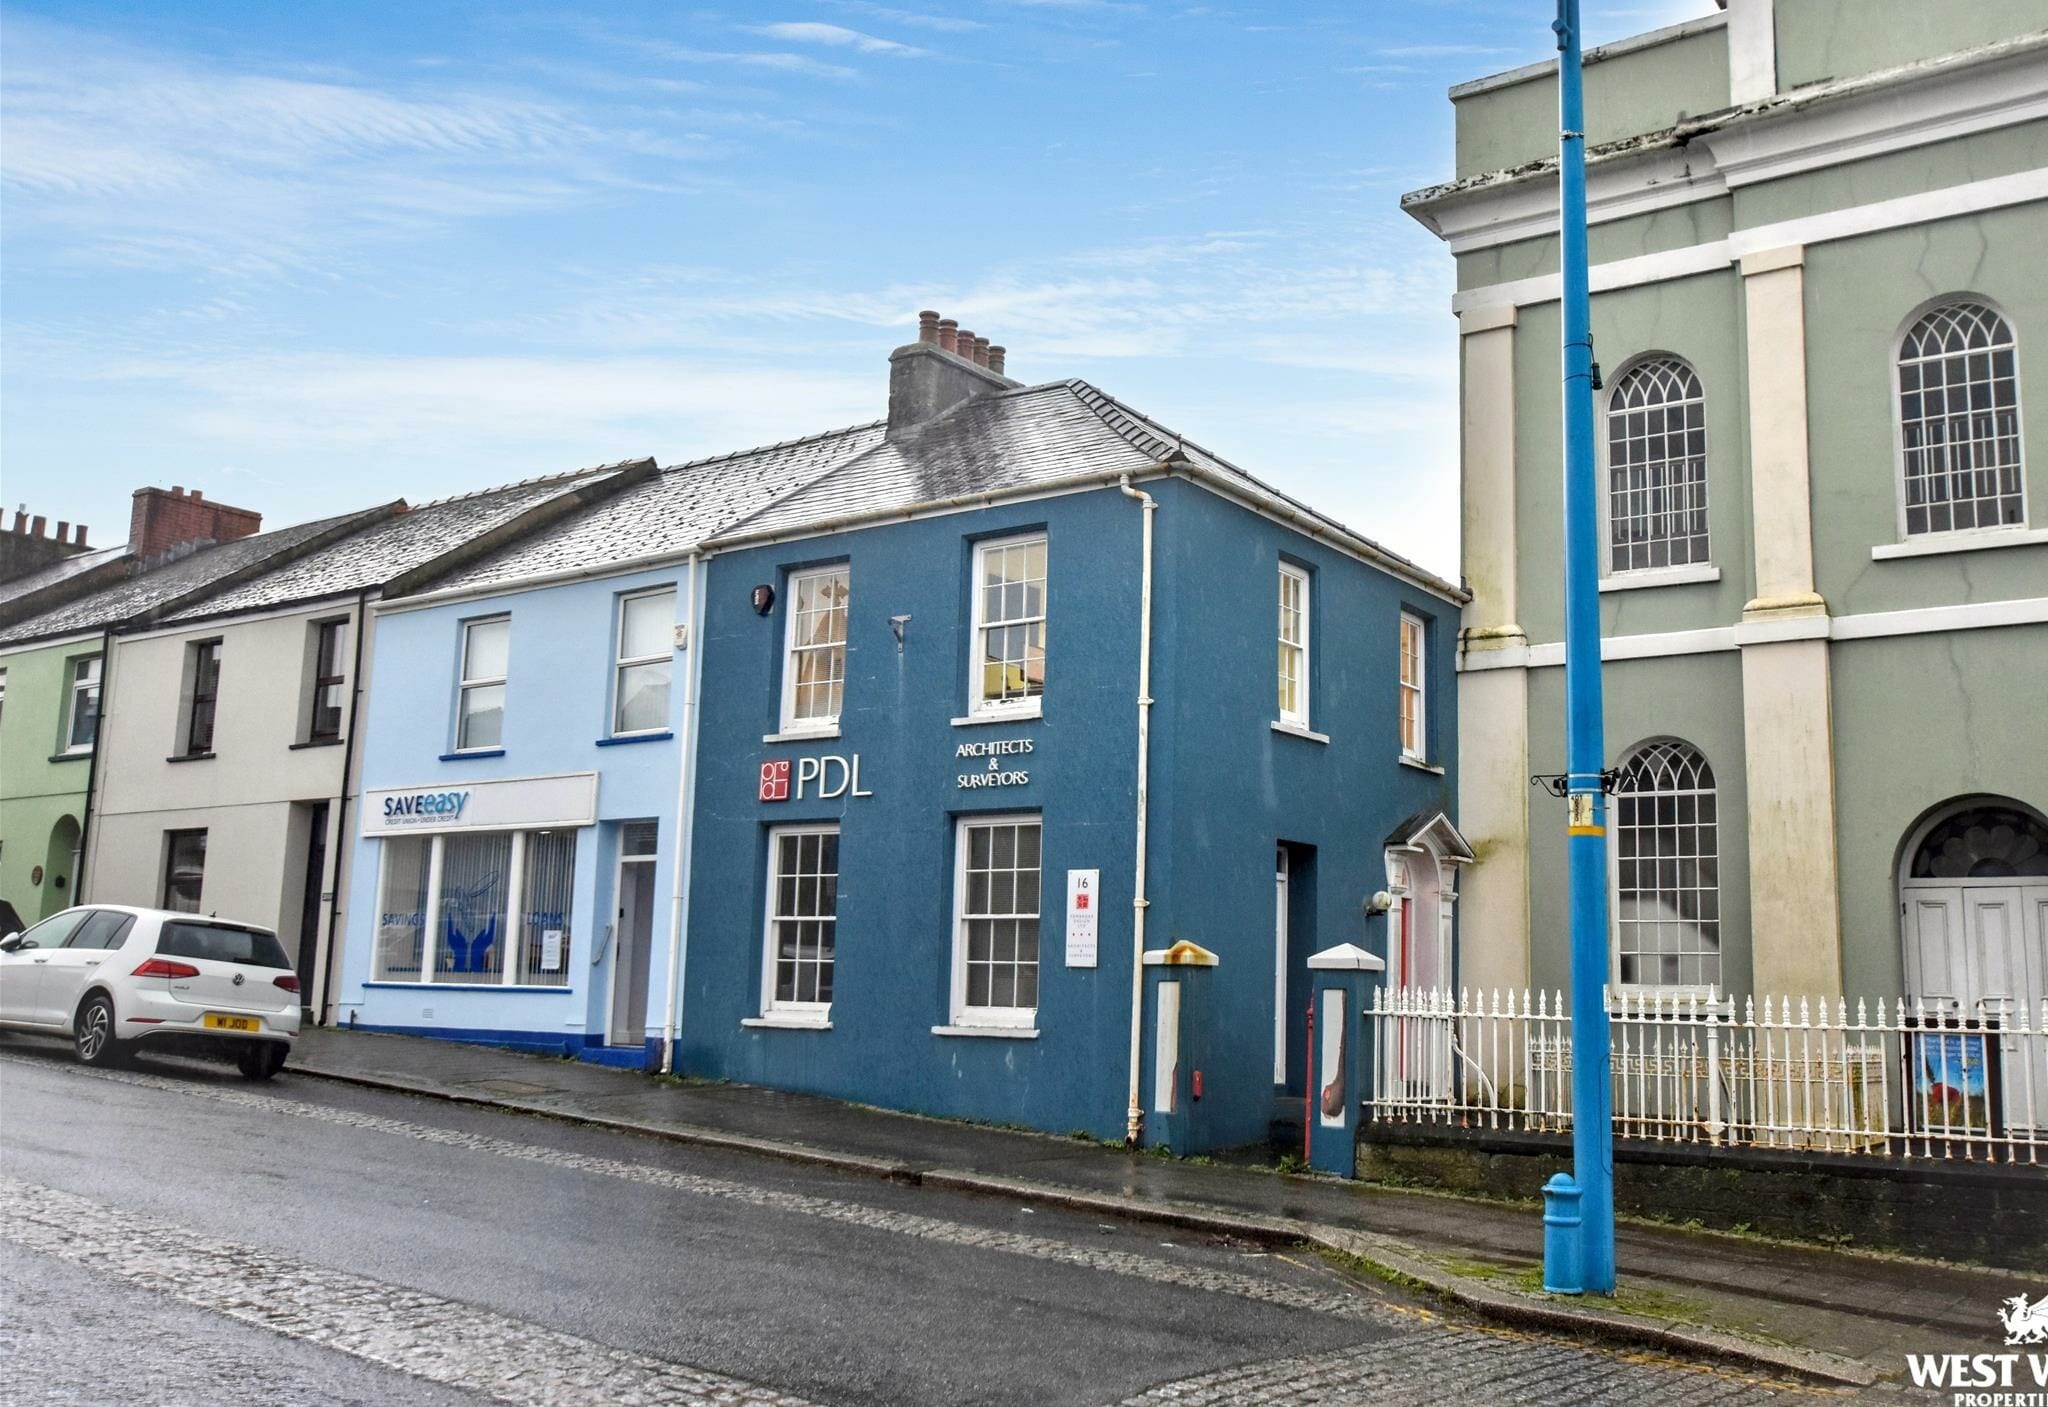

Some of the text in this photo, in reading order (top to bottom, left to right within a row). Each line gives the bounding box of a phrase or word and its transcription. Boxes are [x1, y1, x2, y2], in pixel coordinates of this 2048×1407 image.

[955, 739, 1033, 757] ARCHITECTS
[988, 757, 999, 770] &
[797, 754, 873, 799] PDL
[957, 770, 1029, 788] SURVEYORS
[383, 791, 469, 819] SAVEeasy
[1077, 877, 1089, 889] 16
